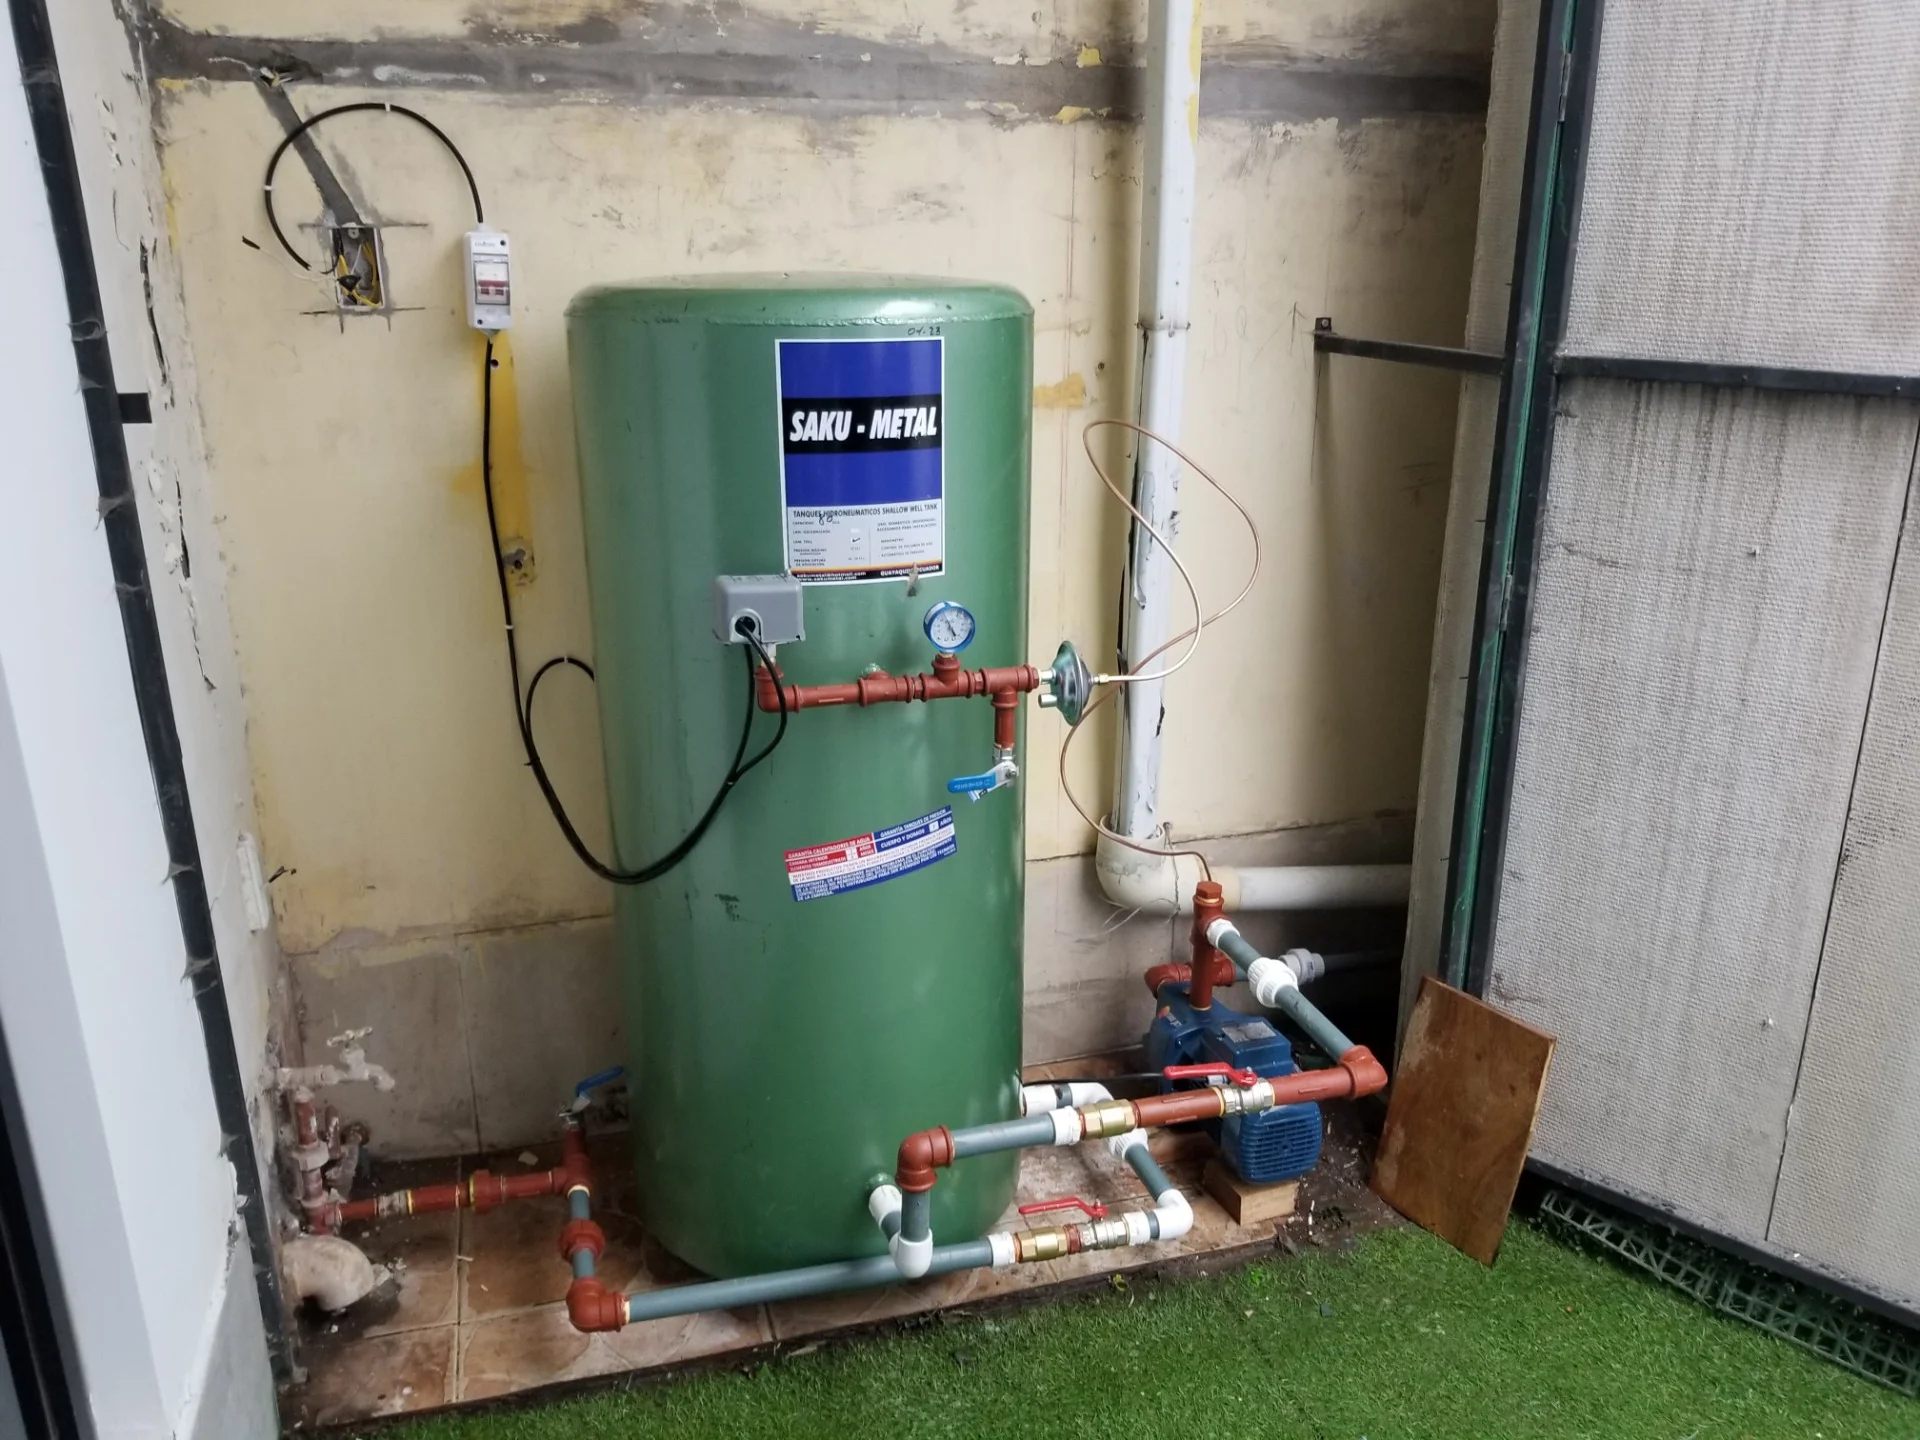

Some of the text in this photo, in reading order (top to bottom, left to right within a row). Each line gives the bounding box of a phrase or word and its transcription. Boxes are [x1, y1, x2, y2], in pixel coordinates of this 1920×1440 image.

[789, 411, 852, 442] SAKU
[869, 407, 938, 440] METAL
[793, 510, 821, 518] TANQUES
[882, 506, 908, 515] SHALLOW
[910, 504, 923, 513] WELL
[880, 836, 902, 849] CUERPO
[902, 834, 907, 844] Y
[906, 829, 925, 842] DOMOS
[940, 816, 952, 828] AÑOS
[788, 851, 812, 859] GARANTÍA
[856, 836, 871, 847] AGUA
